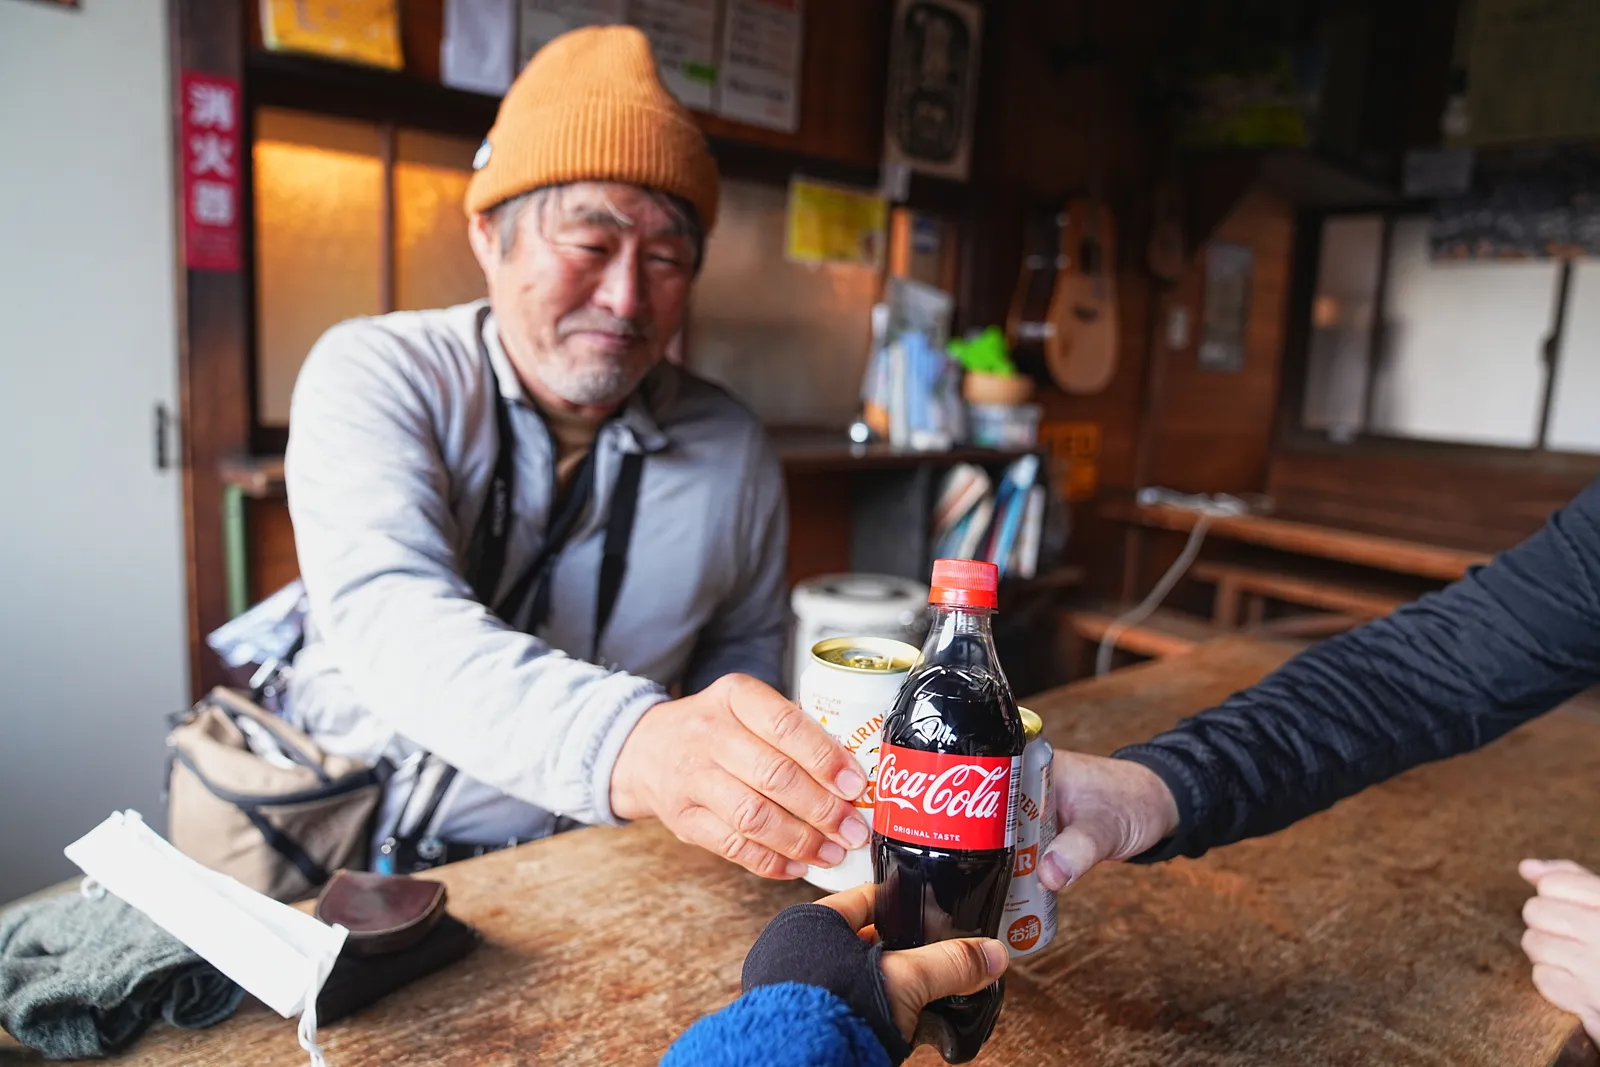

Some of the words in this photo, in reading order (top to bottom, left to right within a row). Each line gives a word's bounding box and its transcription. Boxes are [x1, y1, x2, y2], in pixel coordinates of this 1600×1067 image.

[844, 713, 884, 755] KIRIN
[876, 753, 1009, 818] Coca-Cola
[1019, 792, 1040, 822] REW
[893, 824, 930, 838] ORIGINAL
[933, 831, 961, 842] TASTE
[1009, 922, 1039, 943] お酒
